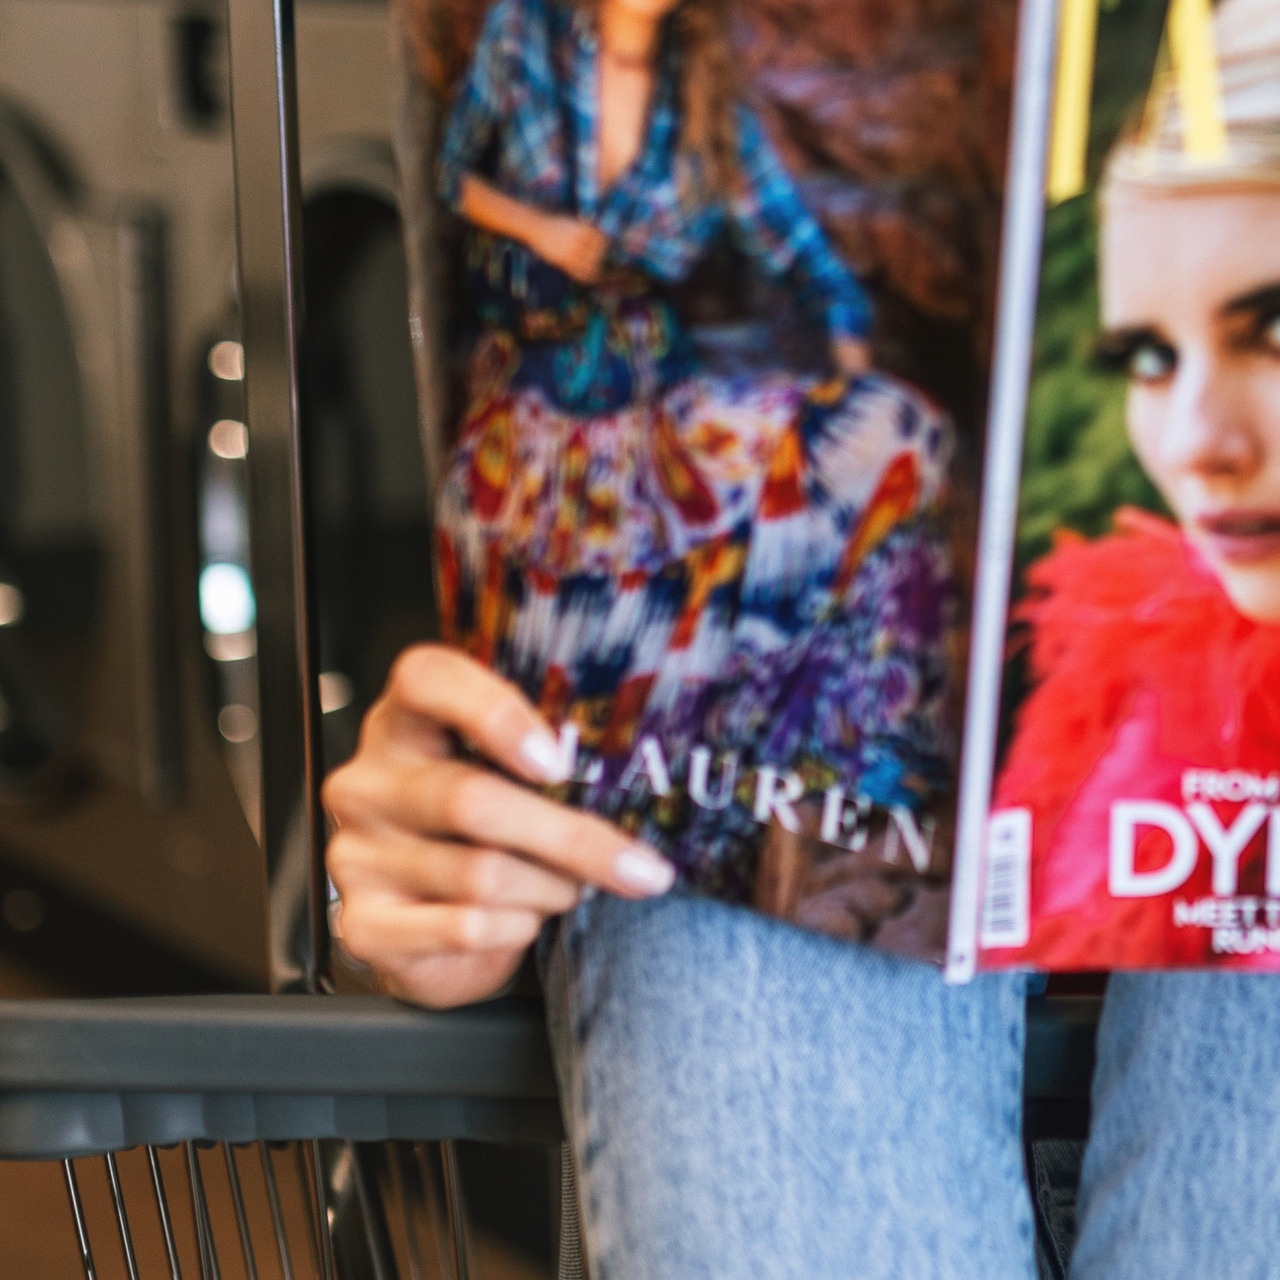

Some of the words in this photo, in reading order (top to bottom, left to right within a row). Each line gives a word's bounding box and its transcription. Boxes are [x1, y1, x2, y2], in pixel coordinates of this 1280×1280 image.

[555, 722, 936, 874] LAUREN
[1181, 768, 1280, 802] FROM
[1172, 896, 1260, 928] MEET
